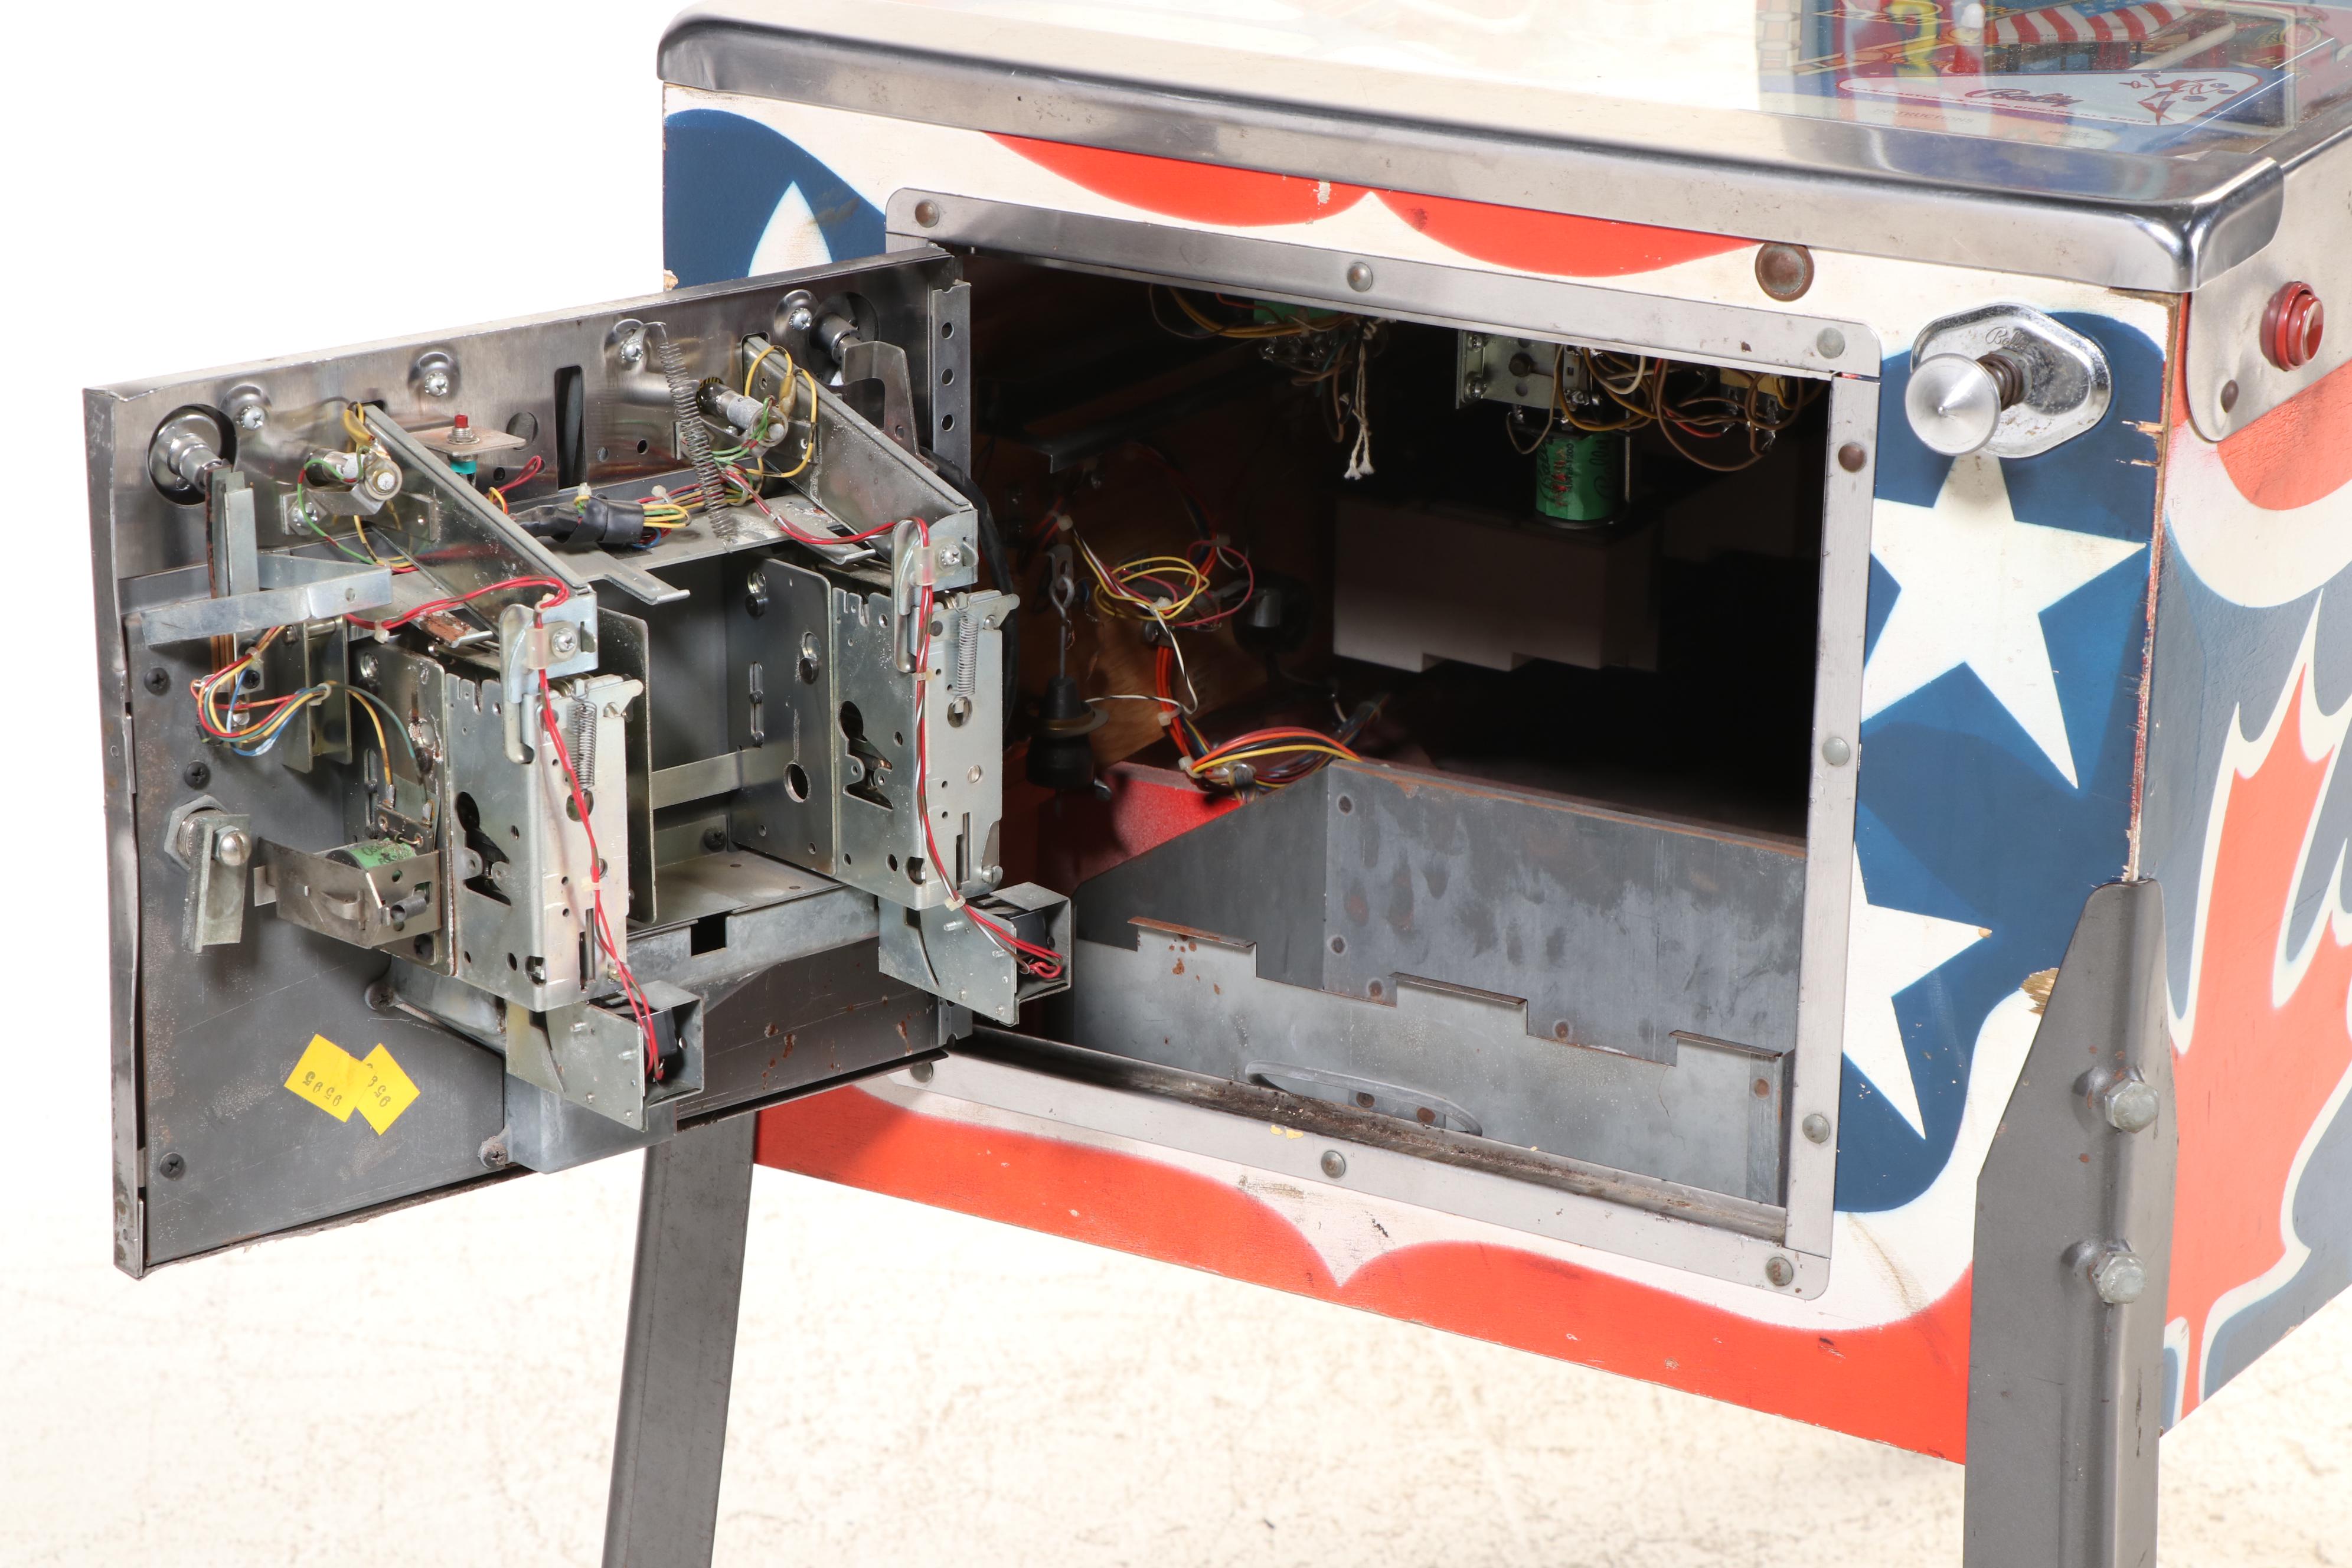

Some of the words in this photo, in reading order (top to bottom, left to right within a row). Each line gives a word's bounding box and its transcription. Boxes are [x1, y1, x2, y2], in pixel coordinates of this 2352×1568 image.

[1848, 87, 1964, 102] MANUFACTURING
[1965, 88, 2083, 107] Bally
[1873, 108, 1974, 123] INSTRUCTIONS
[302, 1070, 342, 1107] 9595
